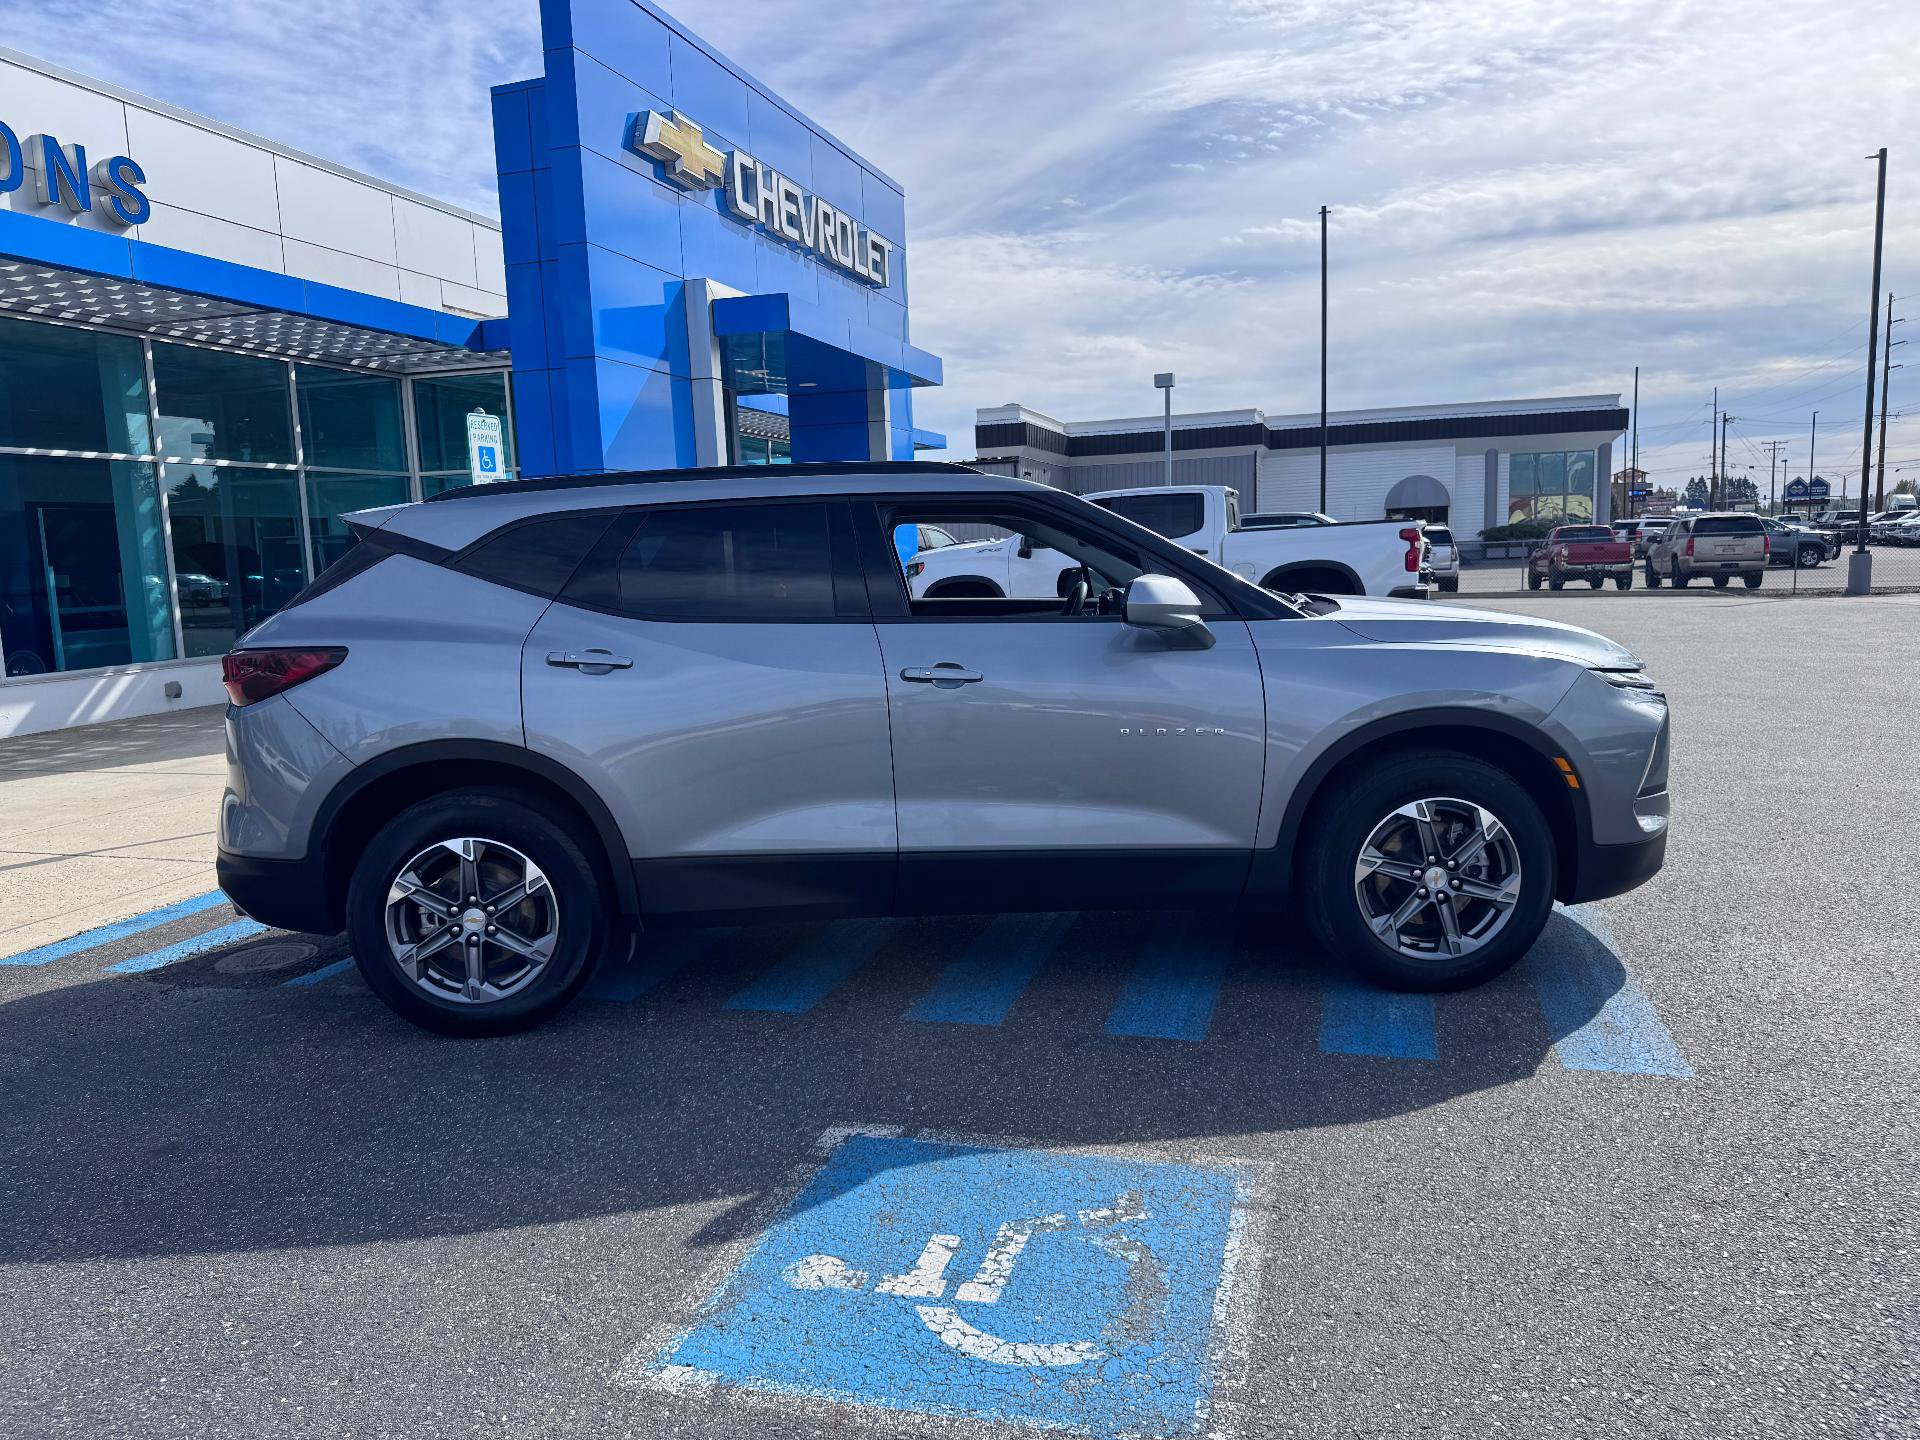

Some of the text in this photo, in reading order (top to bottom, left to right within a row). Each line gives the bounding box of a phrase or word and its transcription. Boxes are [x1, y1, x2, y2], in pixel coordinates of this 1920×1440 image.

[730, 150, 893, 288] CHEVROLET
[470, 419, 498, 432] RESERVED
[473, 432, 498, 444] PARKING
[1119, 728, 1225, 736] BLAZER
